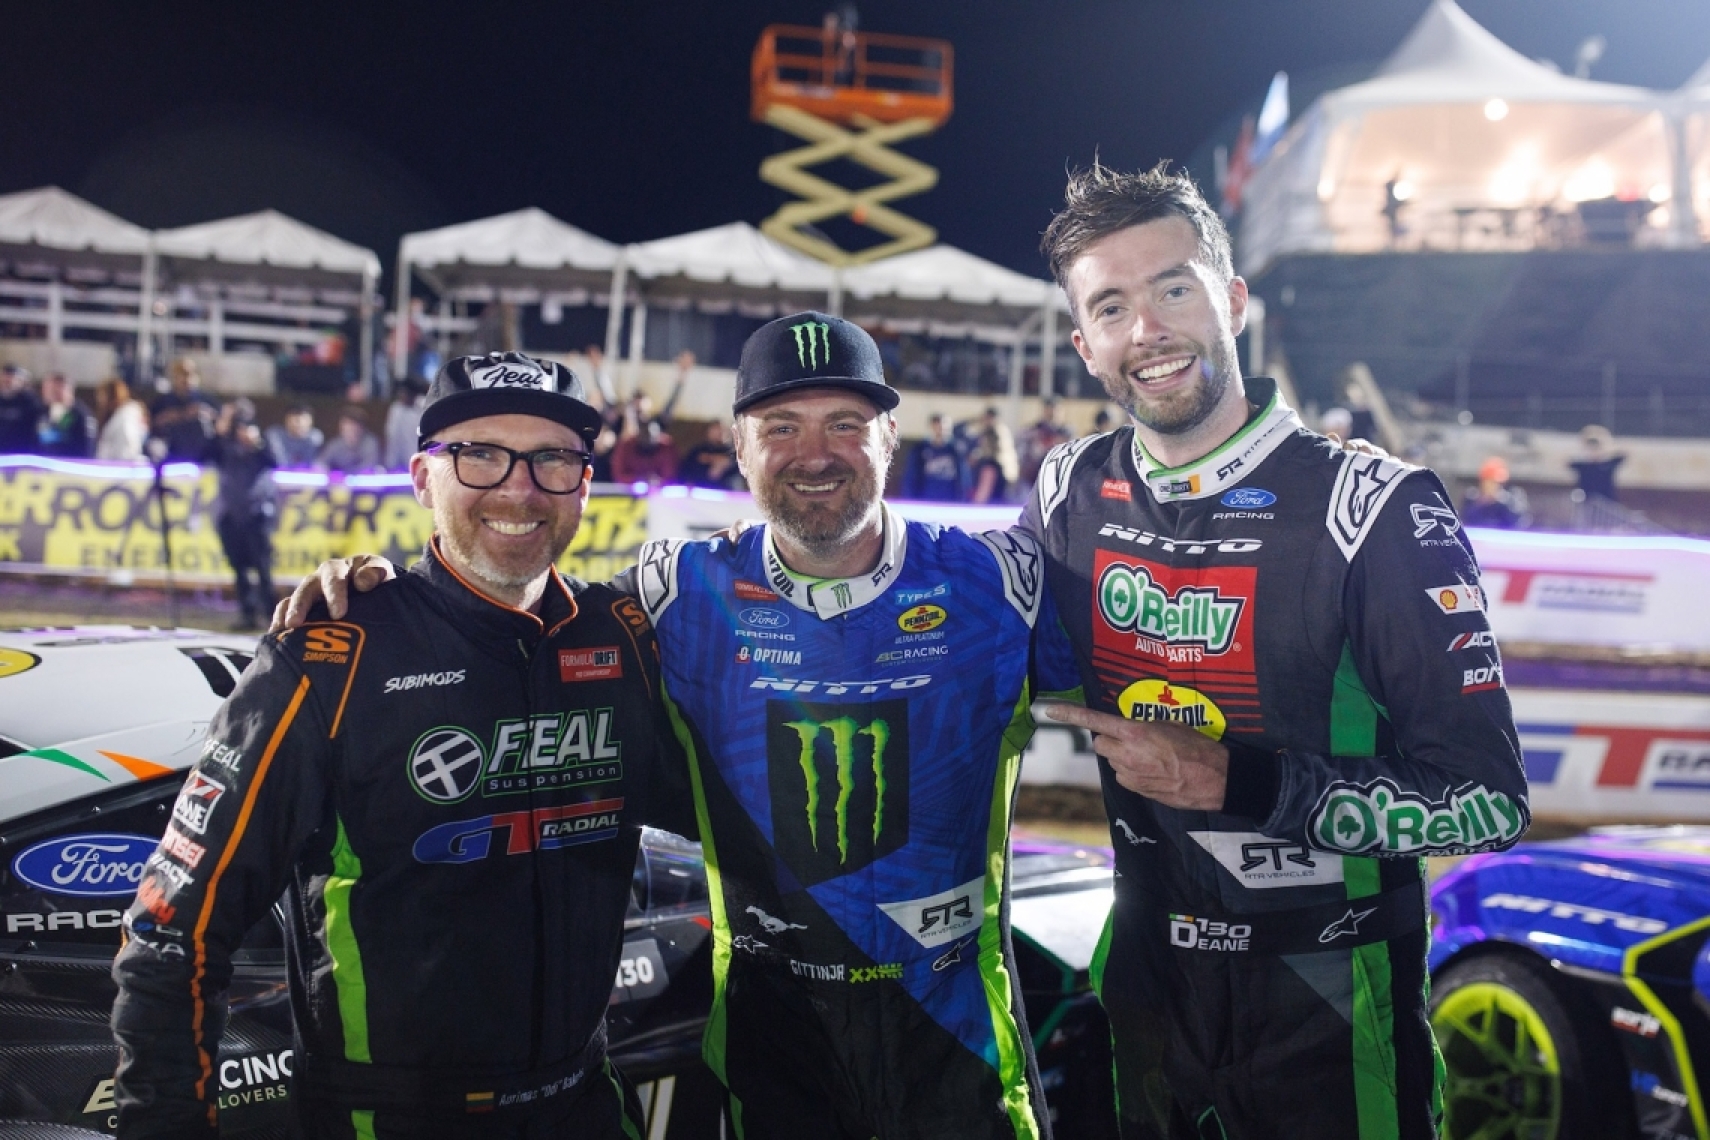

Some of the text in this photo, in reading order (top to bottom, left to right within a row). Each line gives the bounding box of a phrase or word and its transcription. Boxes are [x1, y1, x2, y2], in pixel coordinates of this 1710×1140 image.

[1229, 491, 1264, 506] Ford
[1212, 512, 1275, 520] RACING
[1098, 523, 1264, 554] NITTO
[749, 611, 780, 625] Ford
[1103, 571, 1233, 646] O'Reilly
[735, 629, 796, 641] RACING
[753, 648, 801, 666] OPTIMA
[1135, 637, 1166, 657] AUTO
[303, 653, 349, 664] SIMPSON
[384, 669, 466, 693] SUBIMODS
[750, 675, 932, 695] NITTO
[487, 710, 619, 773] FEAL
[489, 767, 617, 790] Suspension
[412, 797, 625, 864] GT
[542, 814, 619, 836] RADIAL
[1319, 791, 1520, 851] O'Reilly
[1268, 869, 1316, 879] VEHICLES
[6, 908, 122, 933] RAC
[1195, 917, 1252, 938] 130
